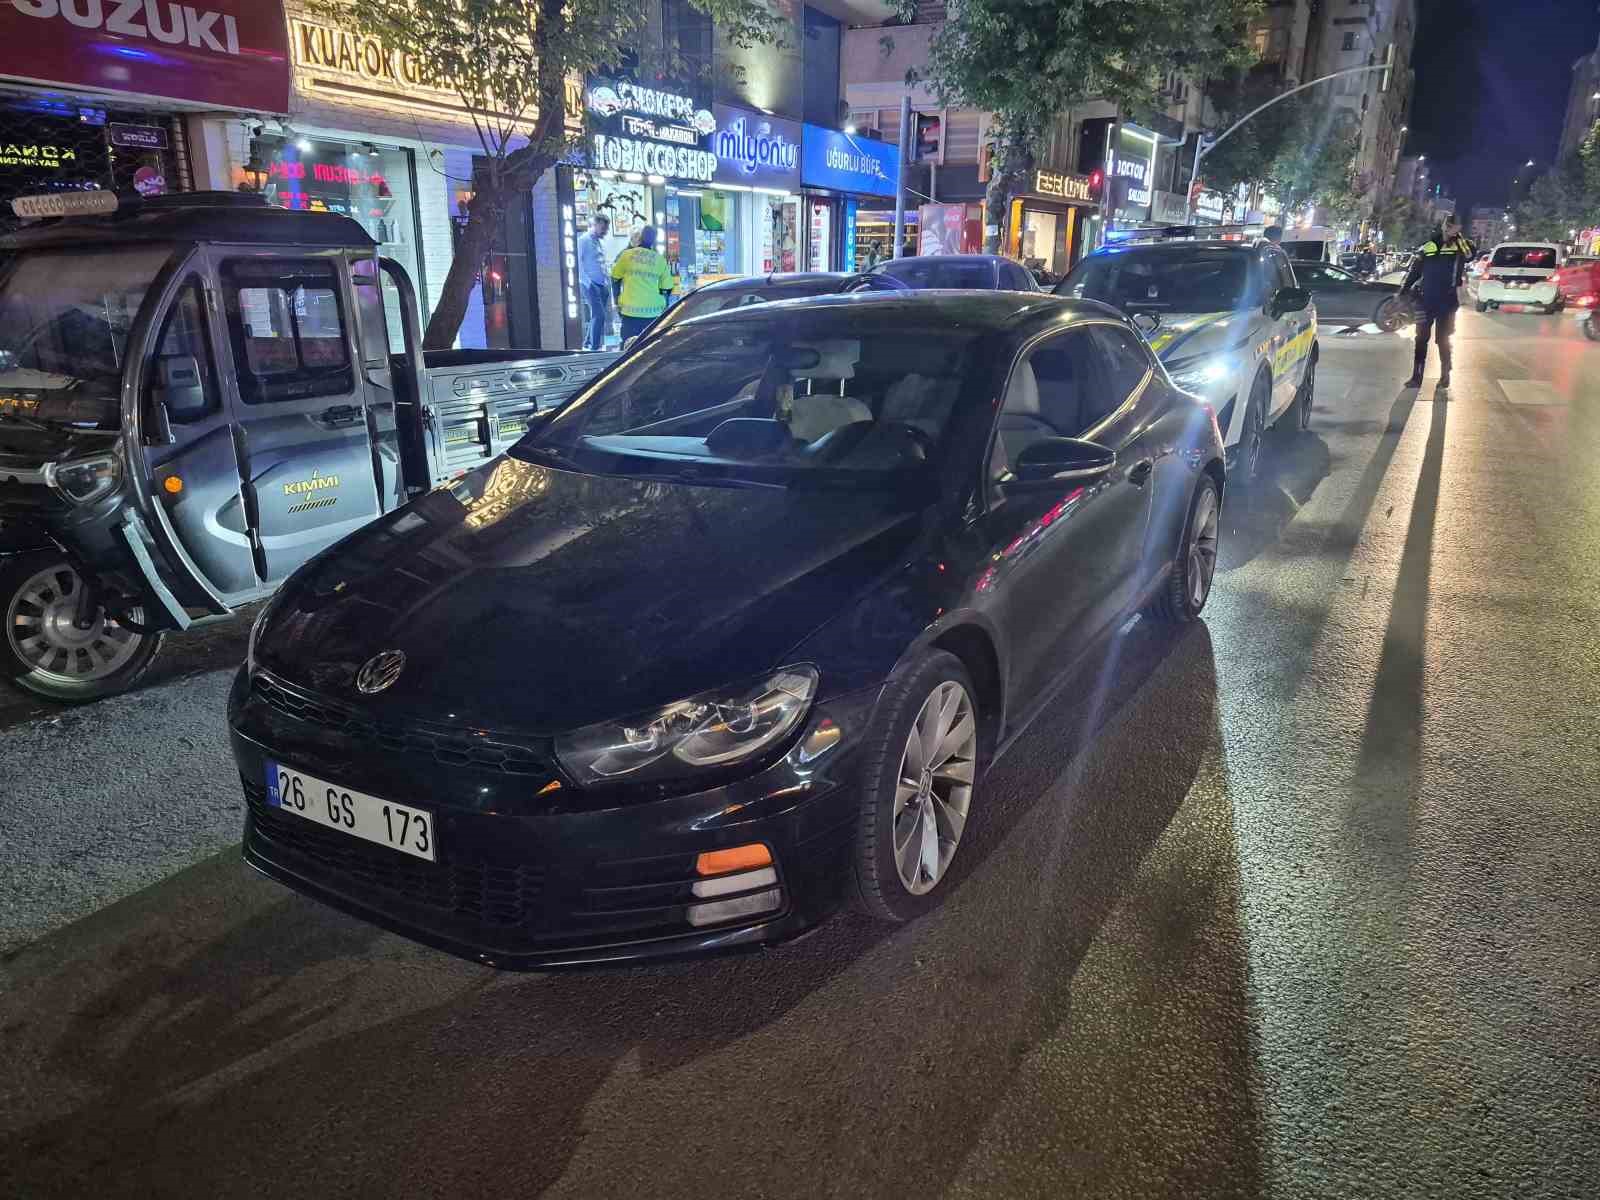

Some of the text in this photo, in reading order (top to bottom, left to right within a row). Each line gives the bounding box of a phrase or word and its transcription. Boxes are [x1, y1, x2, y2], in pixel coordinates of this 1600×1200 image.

[677, 147, 718, 181] SHOP
[279, 771, 430, 852] 26 GS 173
